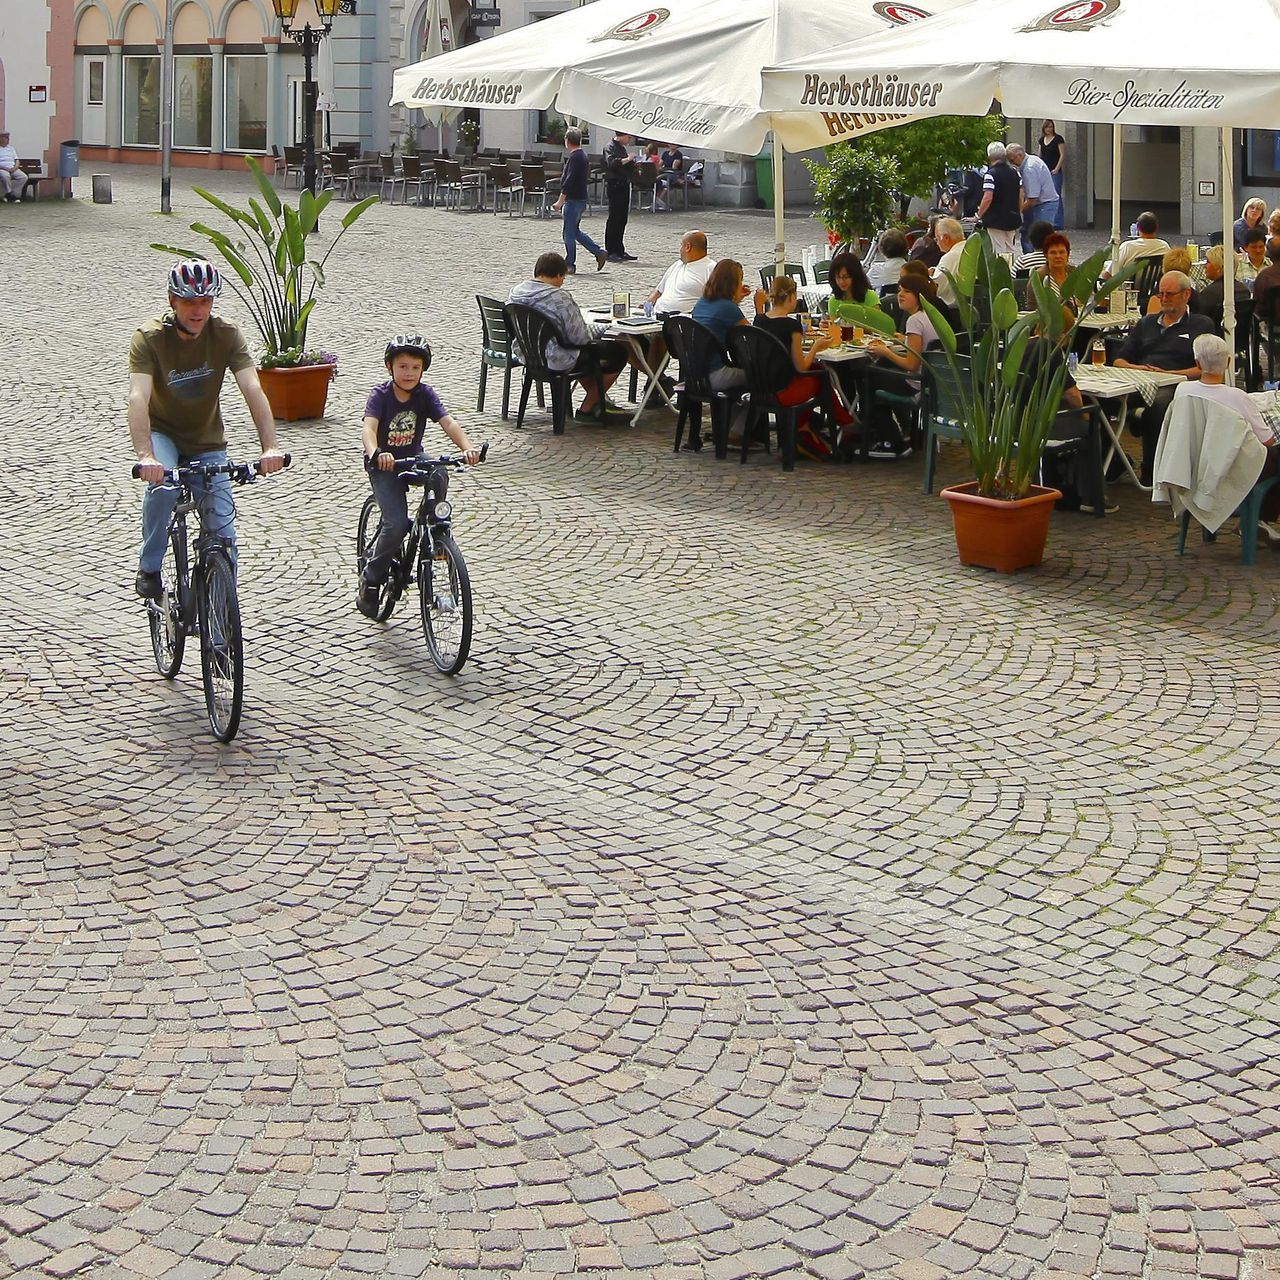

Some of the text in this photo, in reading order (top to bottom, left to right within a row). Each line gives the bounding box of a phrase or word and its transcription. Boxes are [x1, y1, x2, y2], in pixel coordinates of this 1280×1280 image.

[411, 77, 523, 105] Herbsthäuser
[800, 73, 944, 108] Herbsthäuser
[1062, 77, 1225, 120] Bier-Spezialitäten
[606, 96, 719, 136] Bier-Spezialitäten
